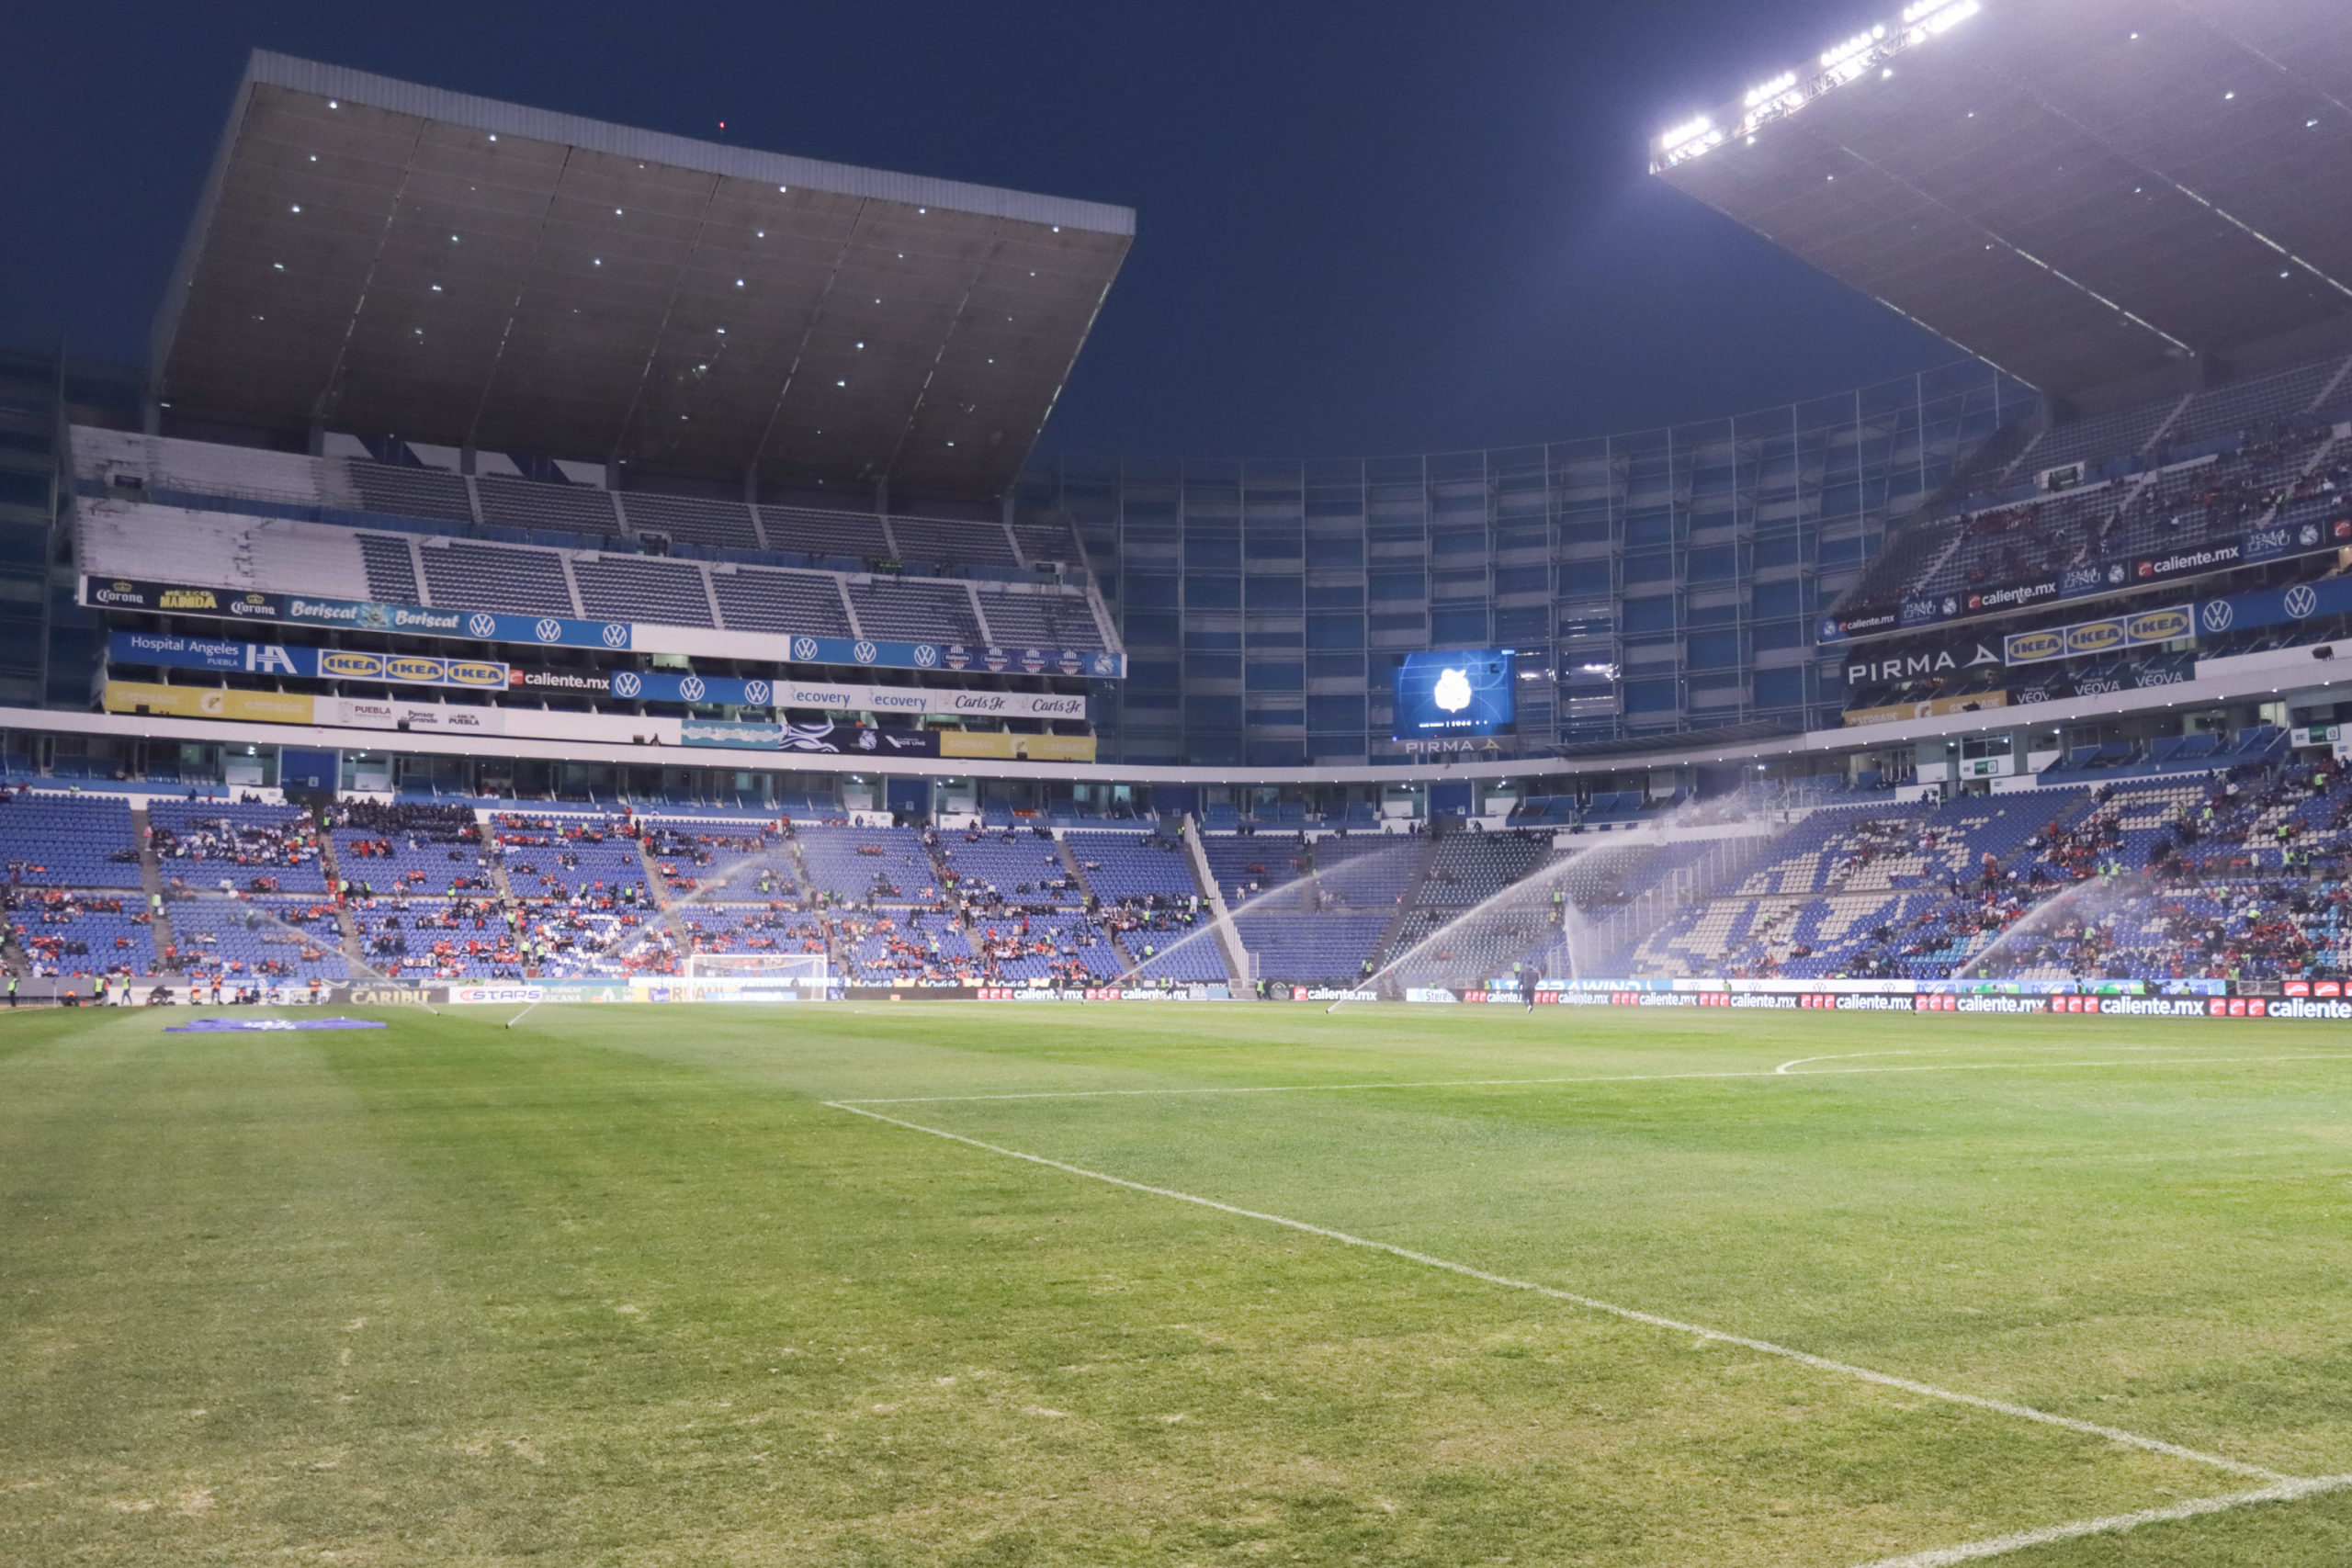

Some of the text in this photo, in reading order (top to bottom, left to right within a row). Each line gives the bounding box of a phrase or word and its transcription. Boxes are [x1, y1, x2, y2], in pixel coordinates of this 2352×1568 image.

[2154, 547, 2239, 573] caliente.mx
[96, 589, 143, 604] Corona
[1982, 581, 2056, 606] caliente.mx
[230, 602, 276, 615] Corona
[1847, 615, 1895, 630] caliente.mx
[2133, 616, 2181, 635] IKEA
[2071, 628, 2120, 645] IKEA
[131, 637, 239, 656] Hospital Angeles
[2013, 637, 2059, 653] IKEA
[207, 658, 238, 667] PUEBLA
[328, 659, 379, 671] IKEA
[391, 660, 440, 675] IKEA
[1849, 650, 1956, 684] PIRMA
[453, 667, 500, 680] IKEA
[525, 672, 610, 690] caliente.mx
[2135, 671, 2183, 688] VEOVA
[2075, 681, 2120, 696] VEOVA
[955, 694, 988, 709] Carl's
[1032, 698, 1064, 712] Carl's
[2018, 691, 2051, 705] VEOV
[355, 705, 391, 715] PUEBLA
[448, 717, 480, 727] PUEBLA
[1405, 739, 1475, 754] PIRMA
[472, 989, 541, 1001] STARS
[1306, 988, 1378, 1002] caliente.mx
[1558, 992, 1609, 1004] caliente.mx
[1639, 992, 1697, 1007] caliente.mx
[1730, 993, 1797, 1009] caliente.mx
[1836, 994, 1913, 1010] caliente.mx
[1957, 995, 2047, 1013] caliente.mx
[2100, 996, 2205, 1015] caliente.mx
[2267, 998, 2352, 1018] caliente
